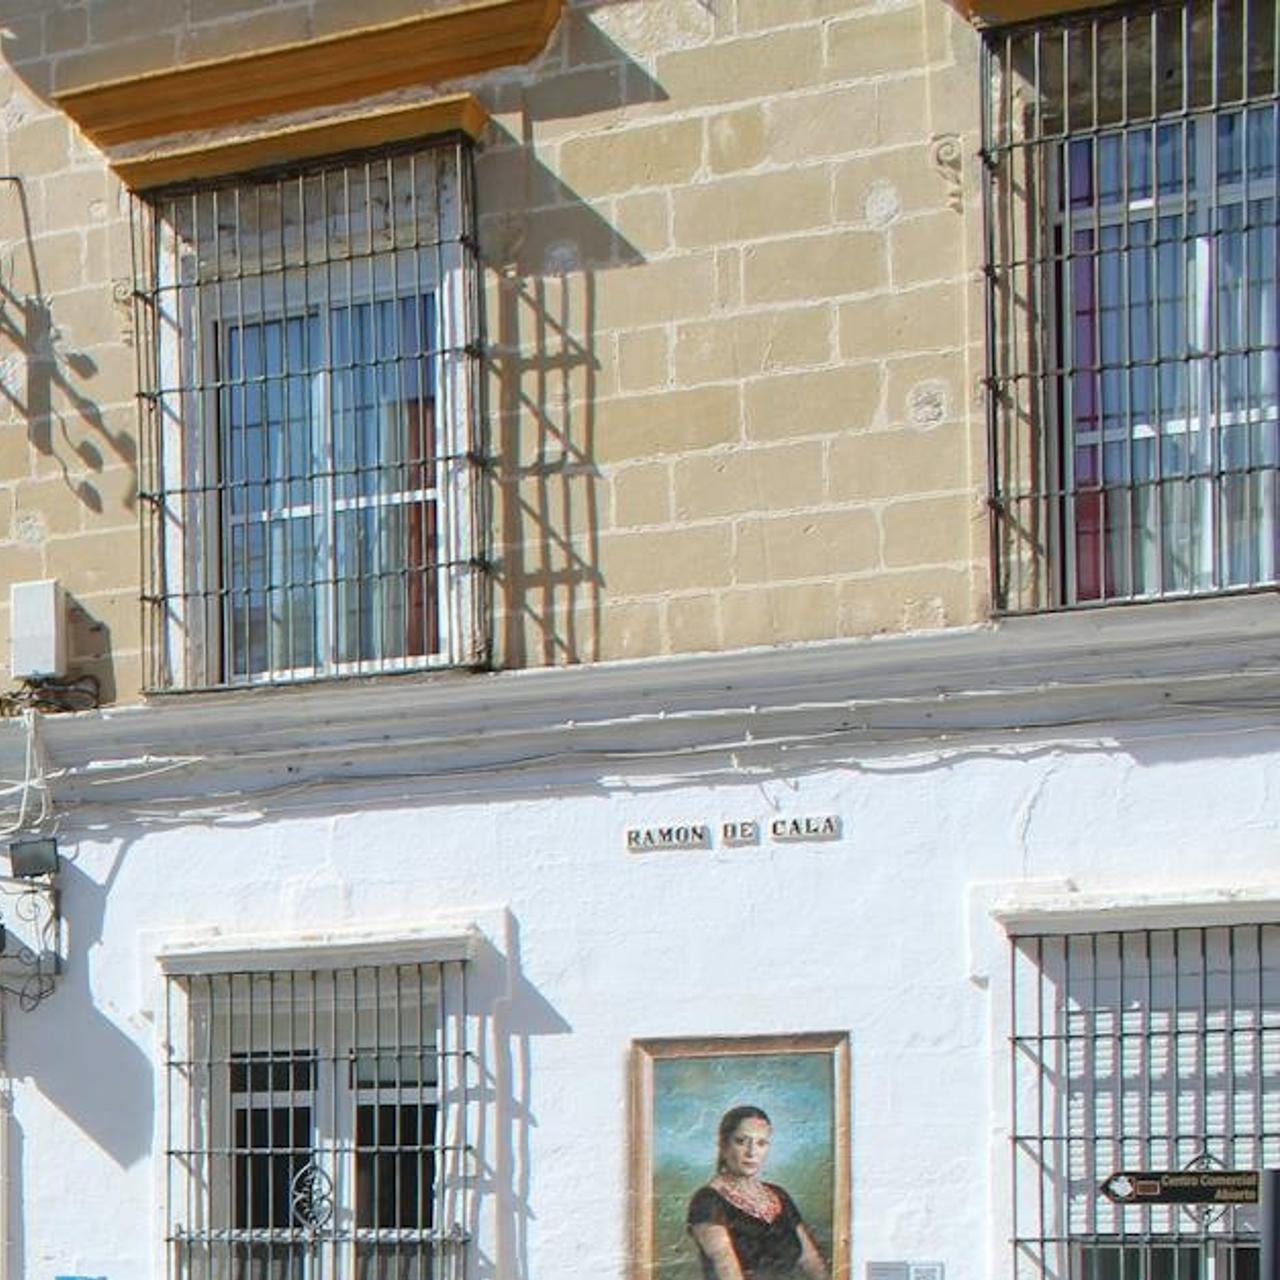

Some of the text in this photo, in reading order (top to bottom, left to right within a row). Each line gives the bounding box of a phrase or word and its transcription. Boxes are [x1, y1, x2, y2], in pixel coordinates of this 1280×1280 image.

[627, 816, 835, 847] RAMON DE CALA
